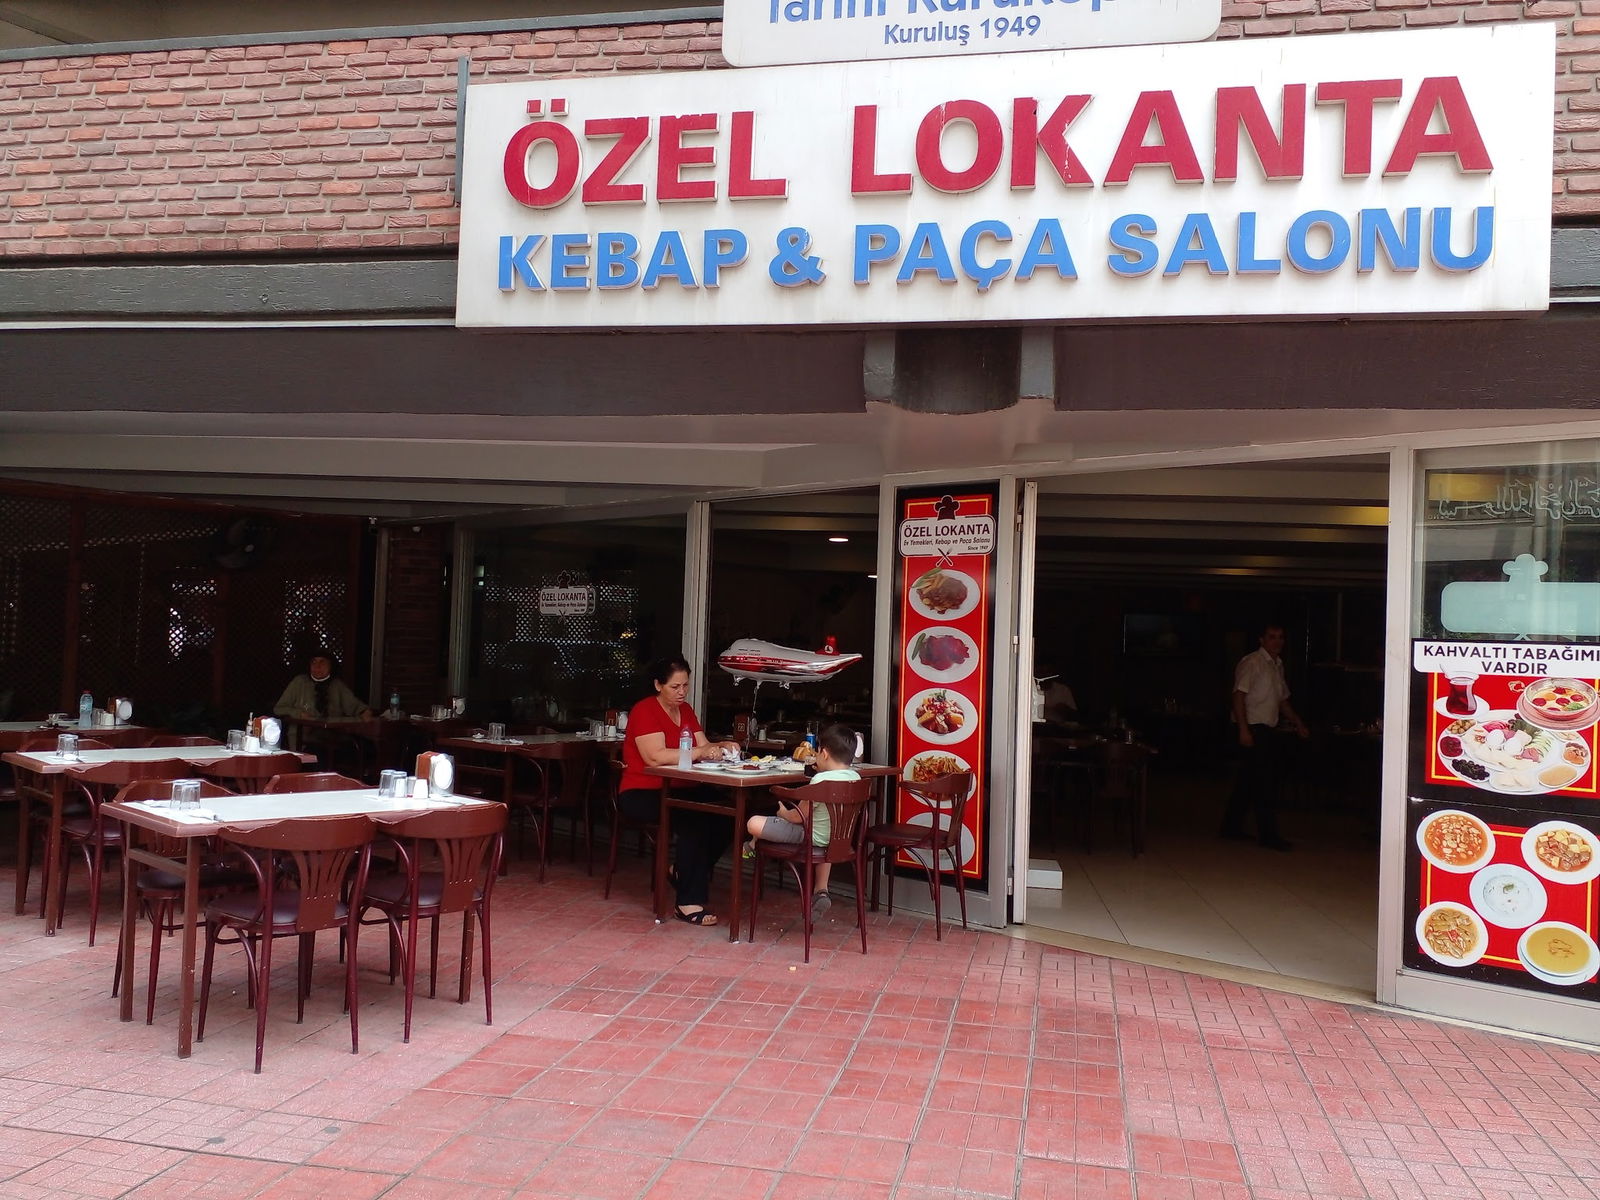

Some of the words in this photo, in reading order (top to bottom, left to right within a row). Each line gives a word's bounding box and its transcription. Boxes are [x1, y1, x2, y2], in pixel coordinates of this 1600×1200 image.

[884, 22, 970, 46] Kuruluş
[980, 15, 1041, 39] 1949
[503, 98, 788, 209] ÖZEL
[851, 76, 1494, 197] LOKANTA
[498, 228, 750, 291] KEBAP
[768, 226, 827, 288] &
[853, 218, 1078, 293] PAÇA
[1107, 206, 1494, 277] SALONU
[903, 525, 932, 538] ÖZEL
[935, 523, 990, 537] LOKANTA
[541, 592, 556, 601] ÖZEL
[557, 592, 586, 601] LOKANTA
[1423, 645, 1507, 659] KAHVALTI
[1481, 661, 1548, 675] VARDIR
